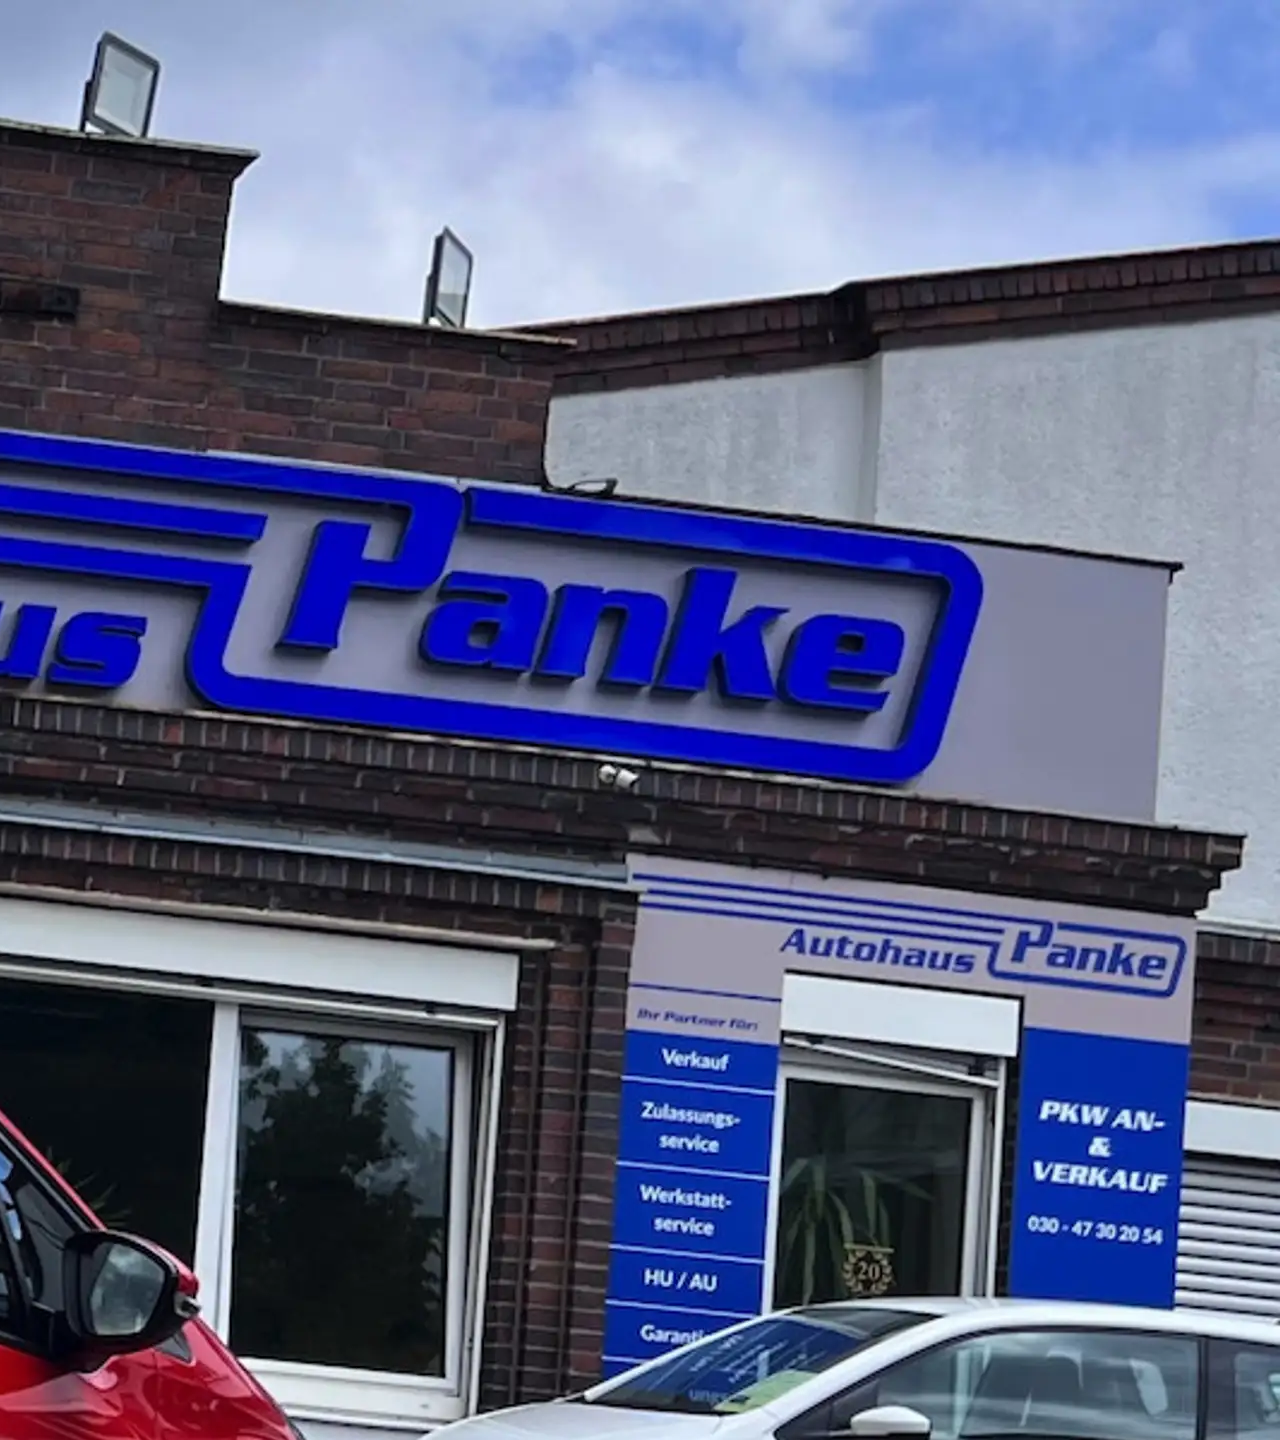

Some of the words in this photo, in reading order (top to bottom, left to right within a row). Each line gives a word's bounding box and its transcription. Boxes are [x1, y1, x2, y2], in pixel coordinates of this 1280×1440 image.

[274, 486, 906, 714] Panke
[780, 928, 975, 974] Autohaus
[1010, 921, 1168, 981] Panke
[637, 1008, 660, 1021] Ihr
[663, 1010, 727, 1029] Partner
[662, 1048, 730, 1071] Verkauf
[641, 1101, 741, 1130] Zulassungs-
[1039, 1100, 1110, 1127] PKW
[1111, 1108, 1167, 1132] AN-
[658, 1134, 720, 1154] service
[1088, 1136, 1113, 1158] &
[1032, 1160, 1169, 1194] VERKAUF
[640, 1183, 732, 1210] Werkstatt-
[653, 1217, 716, 1237] service
[1027, 1215, 1060, 1234] 030
[1071, 1220, 1094, 1237] 47
[1095, 1222, 1117, 1240] 30
[1118, 1225, 1140, 1243] 20
[1141, 1227, 1164, 1245] 54
[644, 1268, 674, 1288] HU
[676, 1271, 688, 1289] /
[688, 1273, 718, 1292] AU
[857, 1260, 881, 1281] 20
